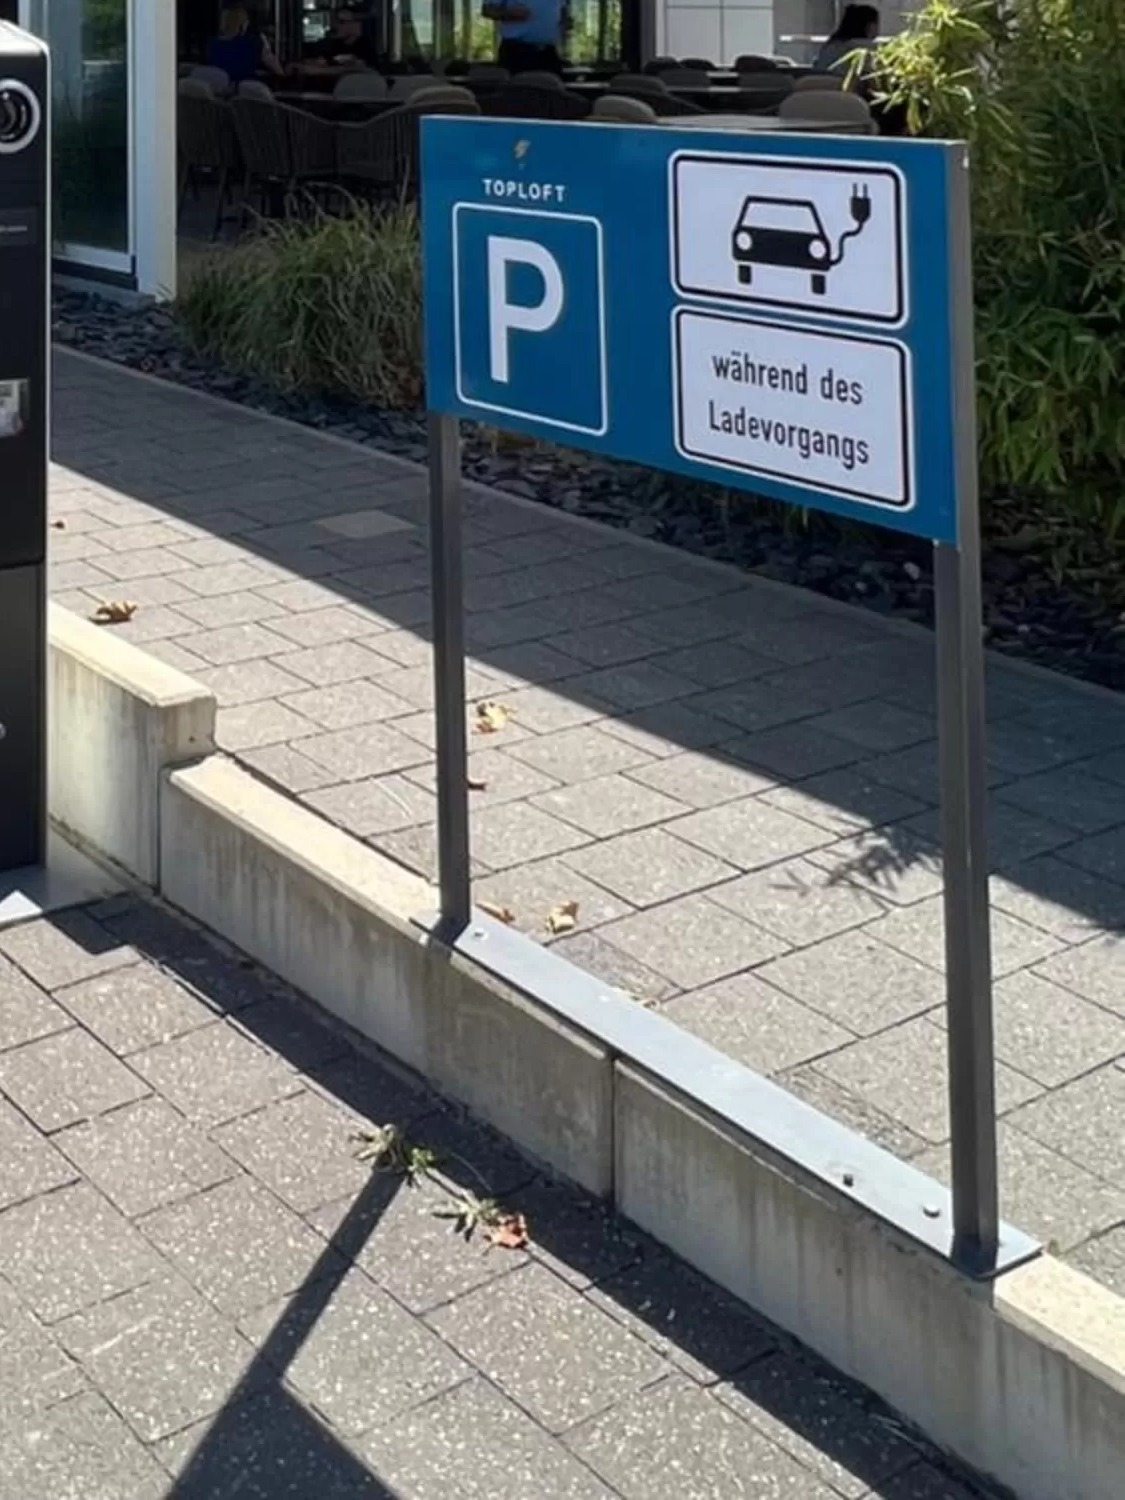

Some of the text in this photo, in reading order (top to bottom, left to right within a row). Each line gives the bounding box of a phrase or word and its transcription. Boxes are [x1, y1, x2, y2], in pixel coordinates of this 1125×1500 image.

[482, 178, 566, 202] TOPLOFT
[487, 235, 564, 384] P
[711, 350, 863, 405] während des
[708, 400, 869, 471] Ladevorgangs
